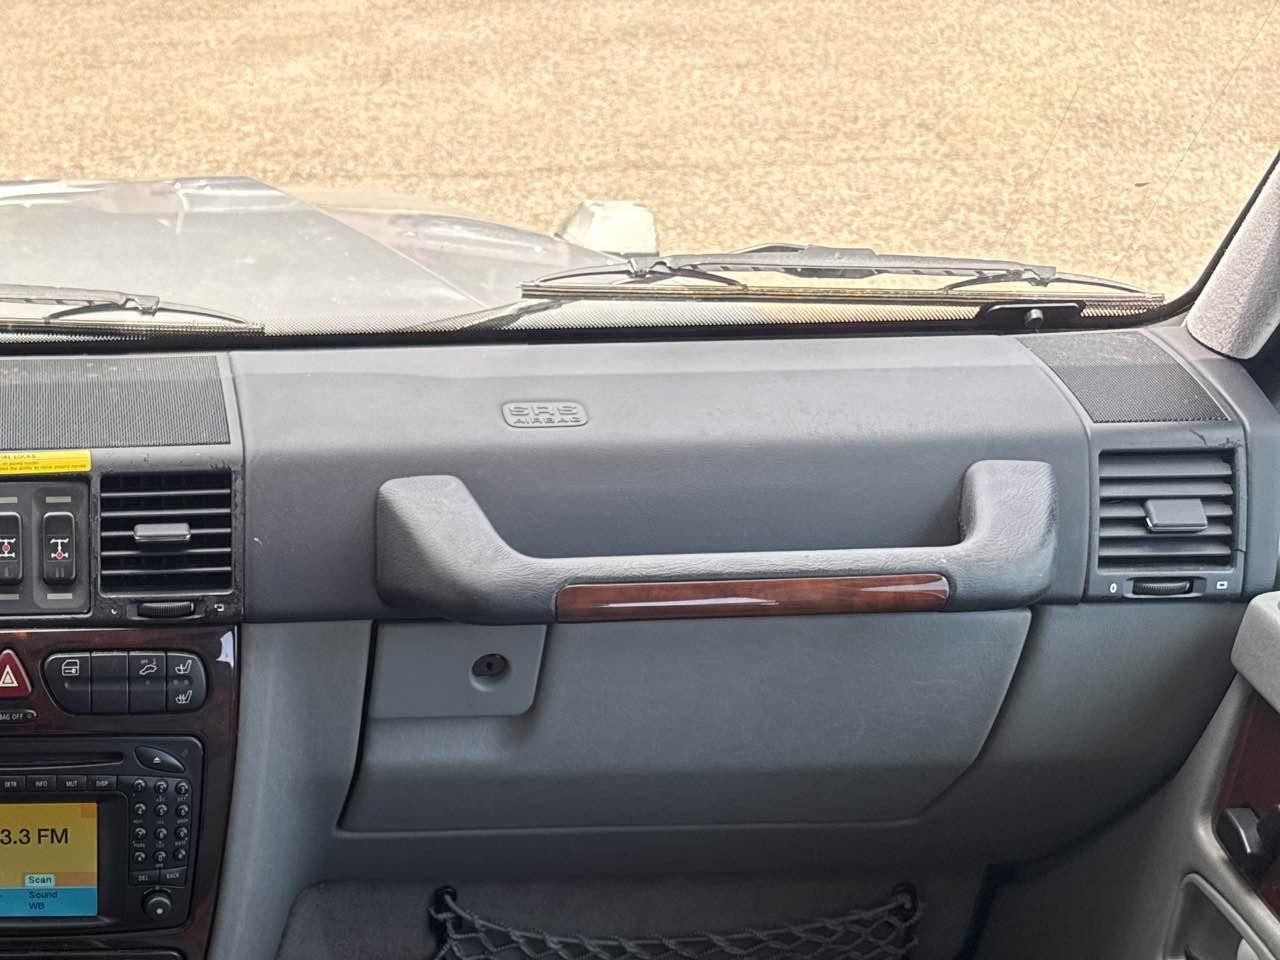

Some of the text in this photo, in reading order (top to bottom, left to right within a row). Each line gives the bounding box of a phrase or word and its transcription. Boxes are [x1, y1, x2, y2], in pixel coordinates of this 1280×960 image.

[508, 404, 578, 417] SRS
[12, 713, 25, 721] OFF
[37, 828, 69, 845] FM
[28, 875, 52, 884] Scan
[28, 890, 58, 899] Sound
[28, 902, 45, 911] WB
